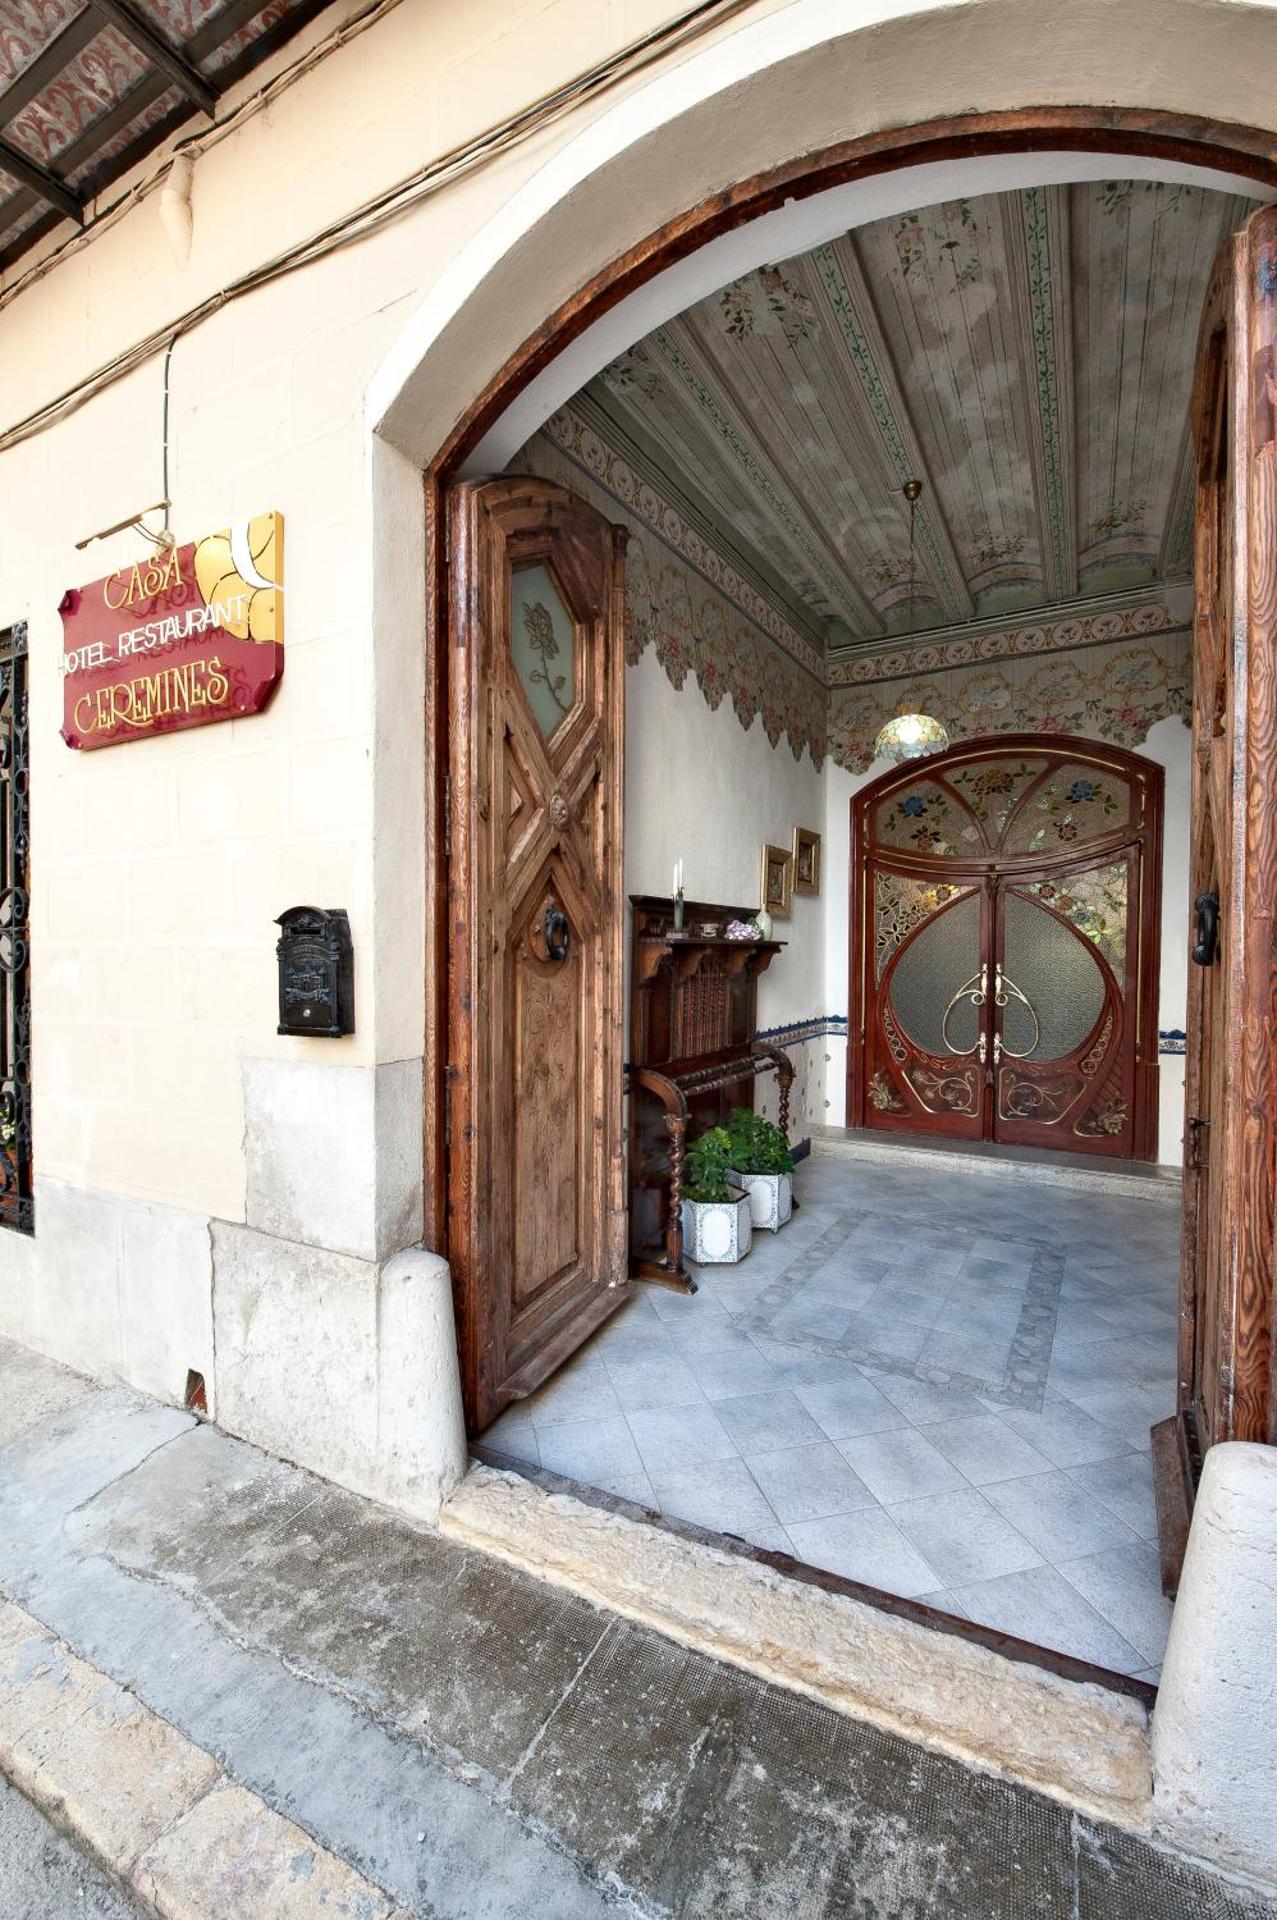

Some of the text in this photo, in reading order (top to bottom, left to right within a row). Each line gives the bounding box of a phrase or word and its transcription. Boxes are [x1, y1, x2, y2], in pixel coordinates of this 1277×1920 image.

[104, 549, 183, 610] CASA
[57, 595, 248, 675] HOTEL RESTAURANT
[74, 656, 229, 734] CEREMINES
